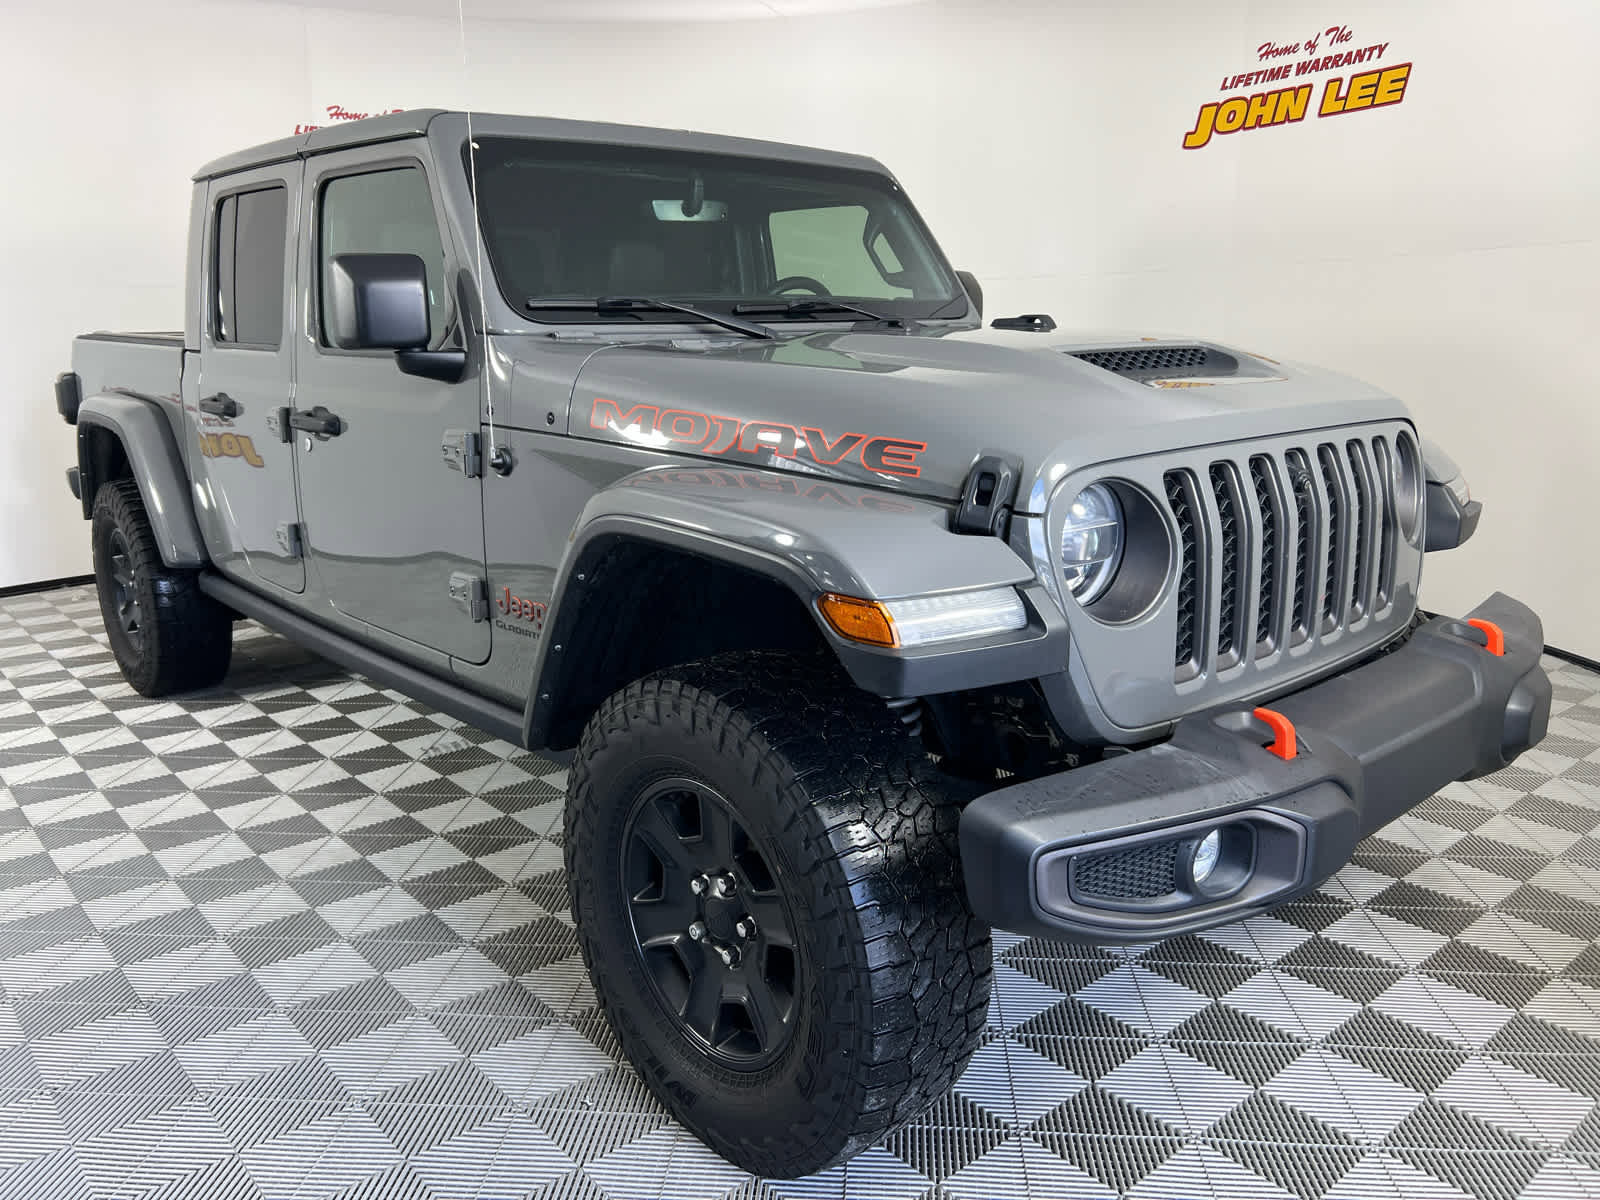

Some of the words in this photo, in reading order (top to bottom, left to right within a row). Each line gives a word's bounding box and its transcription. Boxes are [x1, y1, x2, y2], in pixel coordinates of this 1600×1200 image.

[1220, 64, 1292, 91] LIFETIME
[1295, 42, 1389, 76] WARRANTY
[1257, 42, 1300, 61] Home
[1304, 32, 1320, 54] of
[1325, 24, 1353, 46] The
[1182, 83, 1313, 149] JOHN
[1317, 62, 1412, 118] LEE
[590, 398, 928, 478] MOJAVE
[495, 586, 547, 630] Jeep
